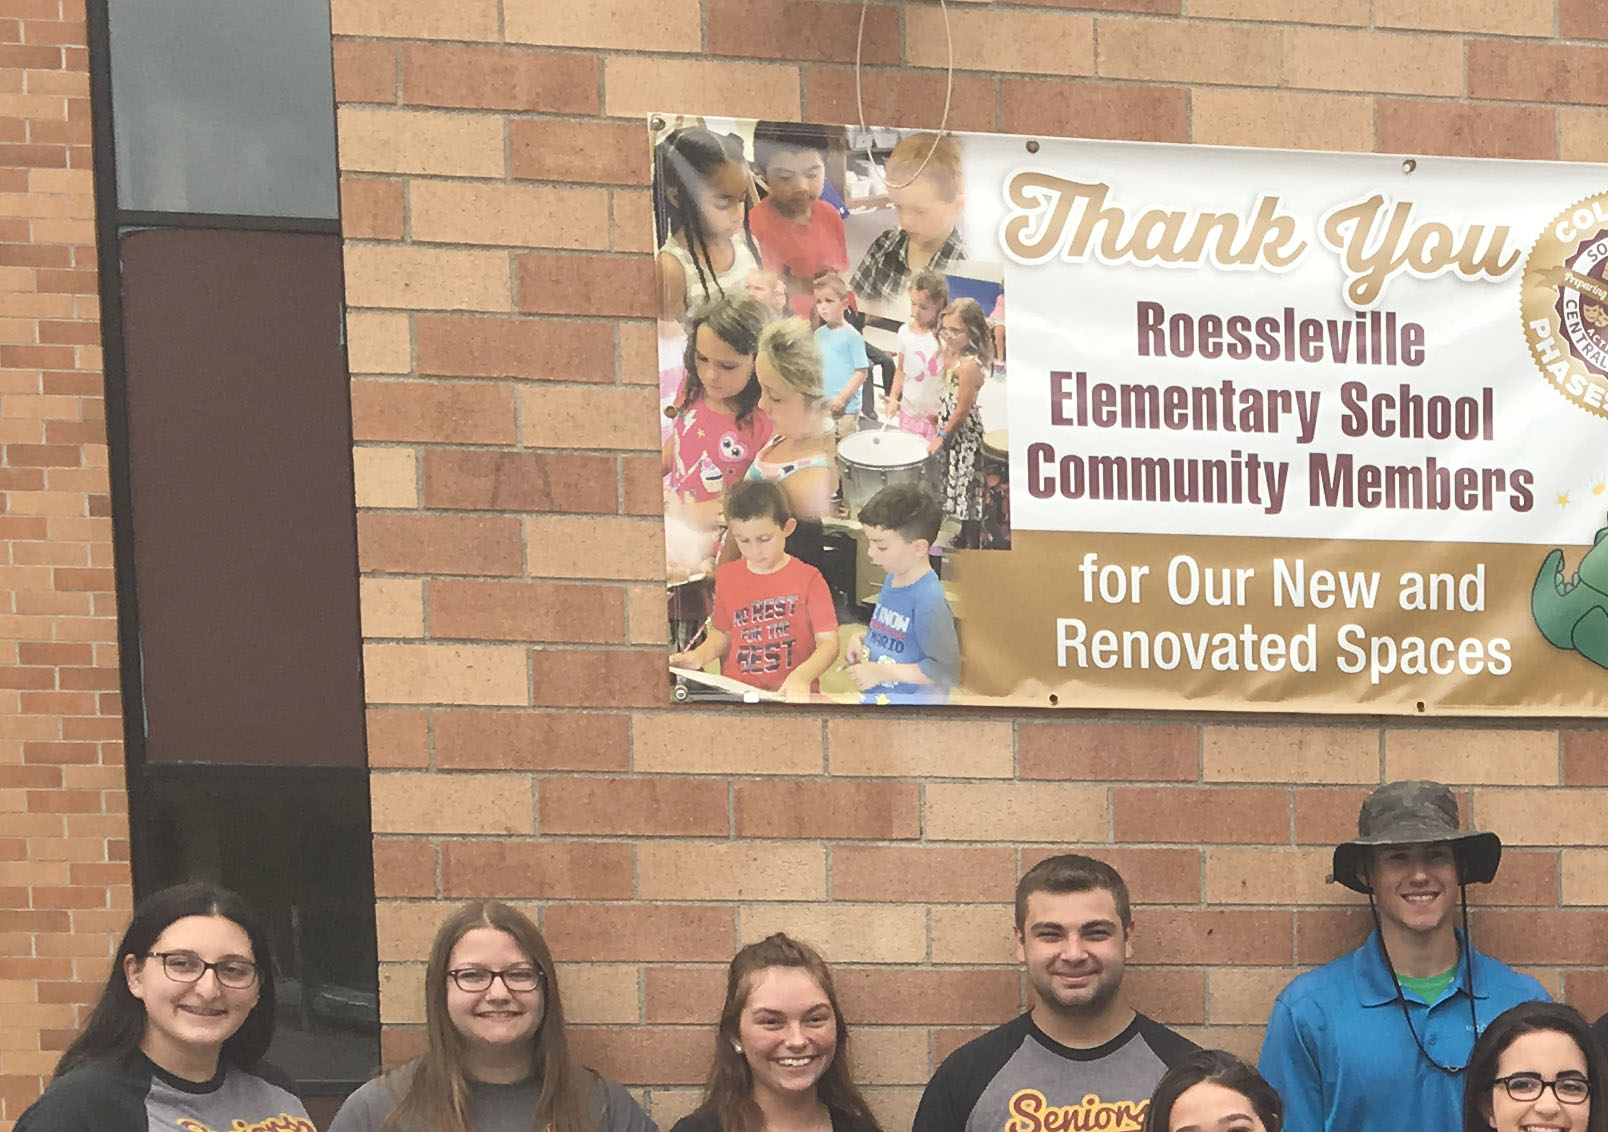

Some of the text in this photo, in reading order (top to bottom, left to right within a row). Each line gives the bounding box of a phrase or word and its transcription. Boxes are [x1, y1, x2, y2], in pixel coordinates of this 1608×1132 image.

[1004, 171, 1522, 306] Thank You
[1564, 272, 1607, 300] Preparing
[1137, 301, 1425, 367] Roessleville
[1565, 299, 1608, 369] CENTRAL
[1050, 371, 1493, 444] Elementary School
[1027, 442, 1534, 515] Community Members
[751, 595, 798, 623] REST
[1078, 552, 1485, 612] for Our New and
[766, 620, 790, 639] THE
[878, 606, 911, 632] KNOW
[737, 637, 796, 674] BEST
[1056, 617, 1512, 685] Renovated Spaces
